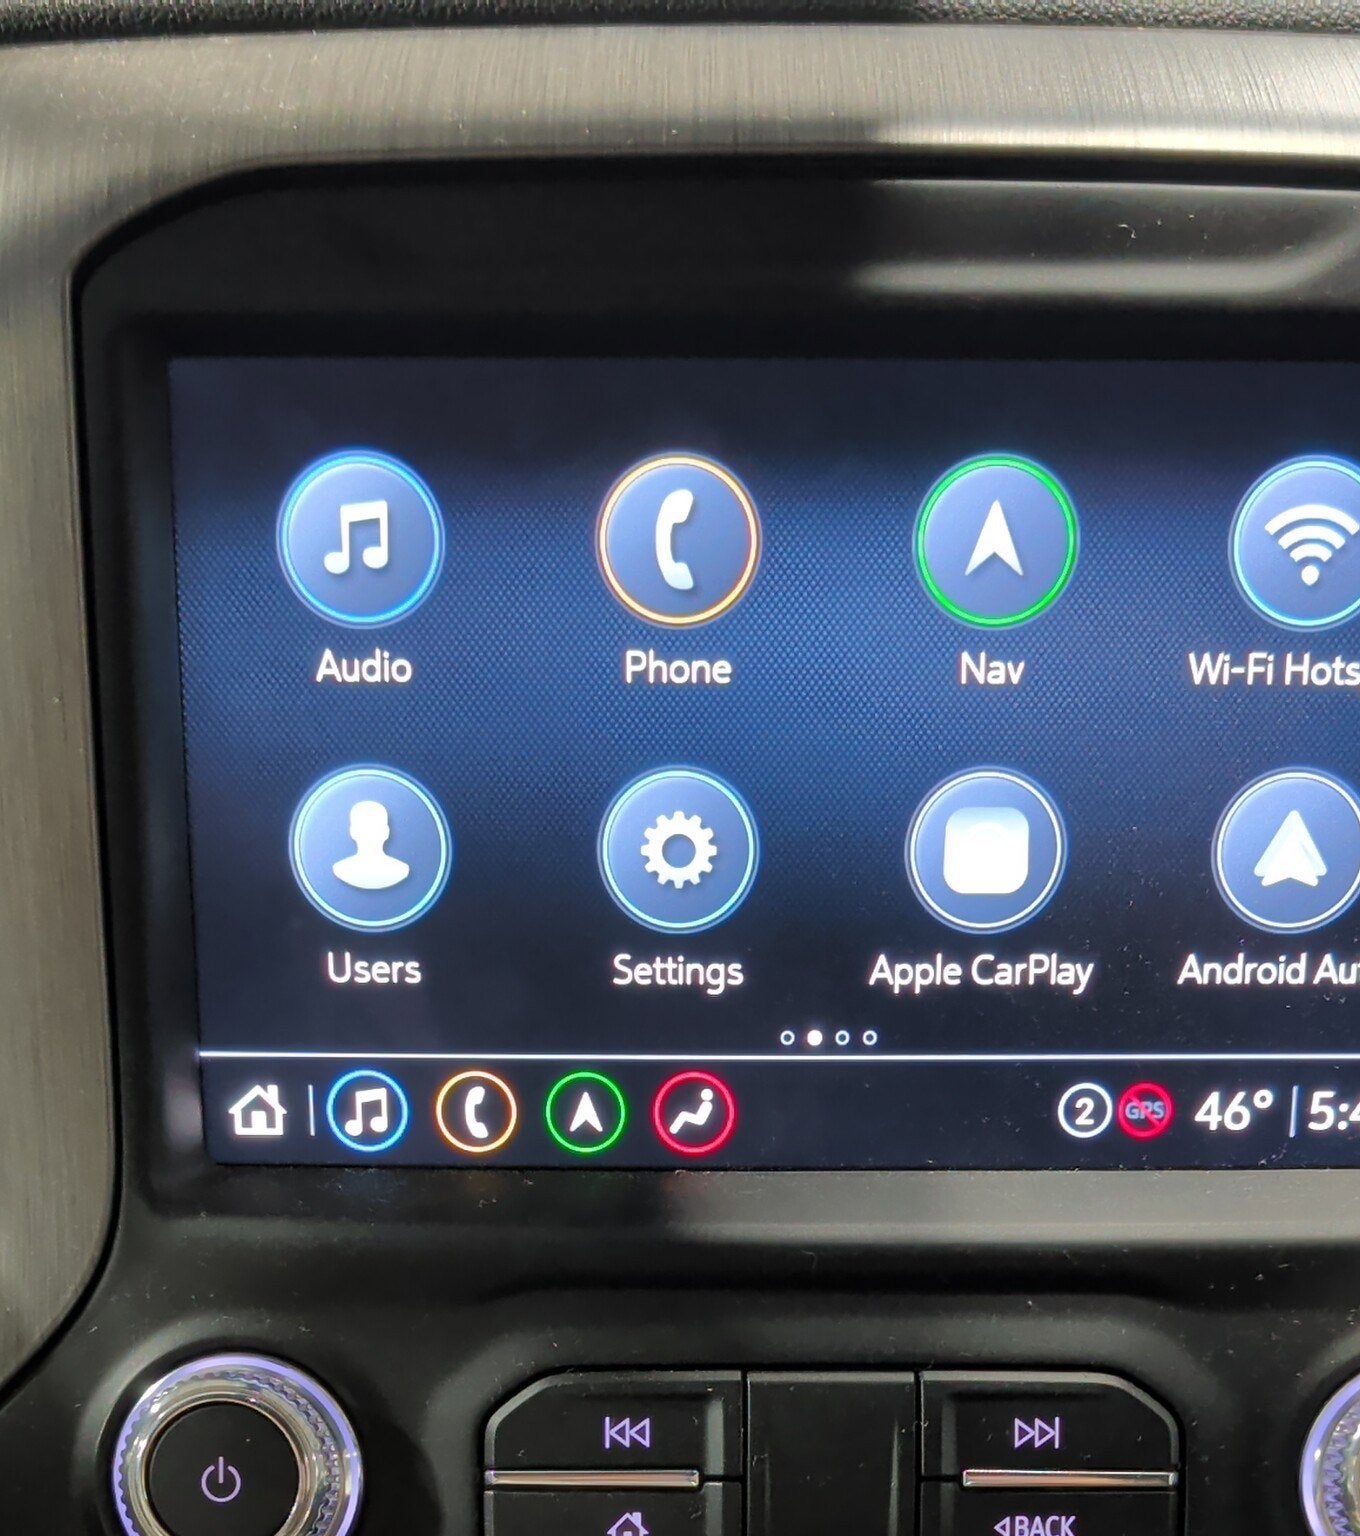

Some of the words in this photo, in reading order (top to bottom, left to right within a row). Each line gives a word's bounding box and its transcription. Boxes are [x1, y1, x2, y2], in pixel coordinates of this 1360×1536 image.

[316, 647, 412, 682] Audio
[625, 650, 732, 684] Phone
[962, 649, 1025, 684] Nav
[1189, 651, 1274, 685] Wi-Fi
[328, 951, 421, 983] Users
[613, 953, 744, 995] Settings
[869, 953, 962, 994] Apple
[971, 953, 1094, 995] CarPlay
[1177, 952, 1307, 984] Android
[1073, 1096, 1096, 1126] 2
[1125, 1101, 1165, 1120] GPS
